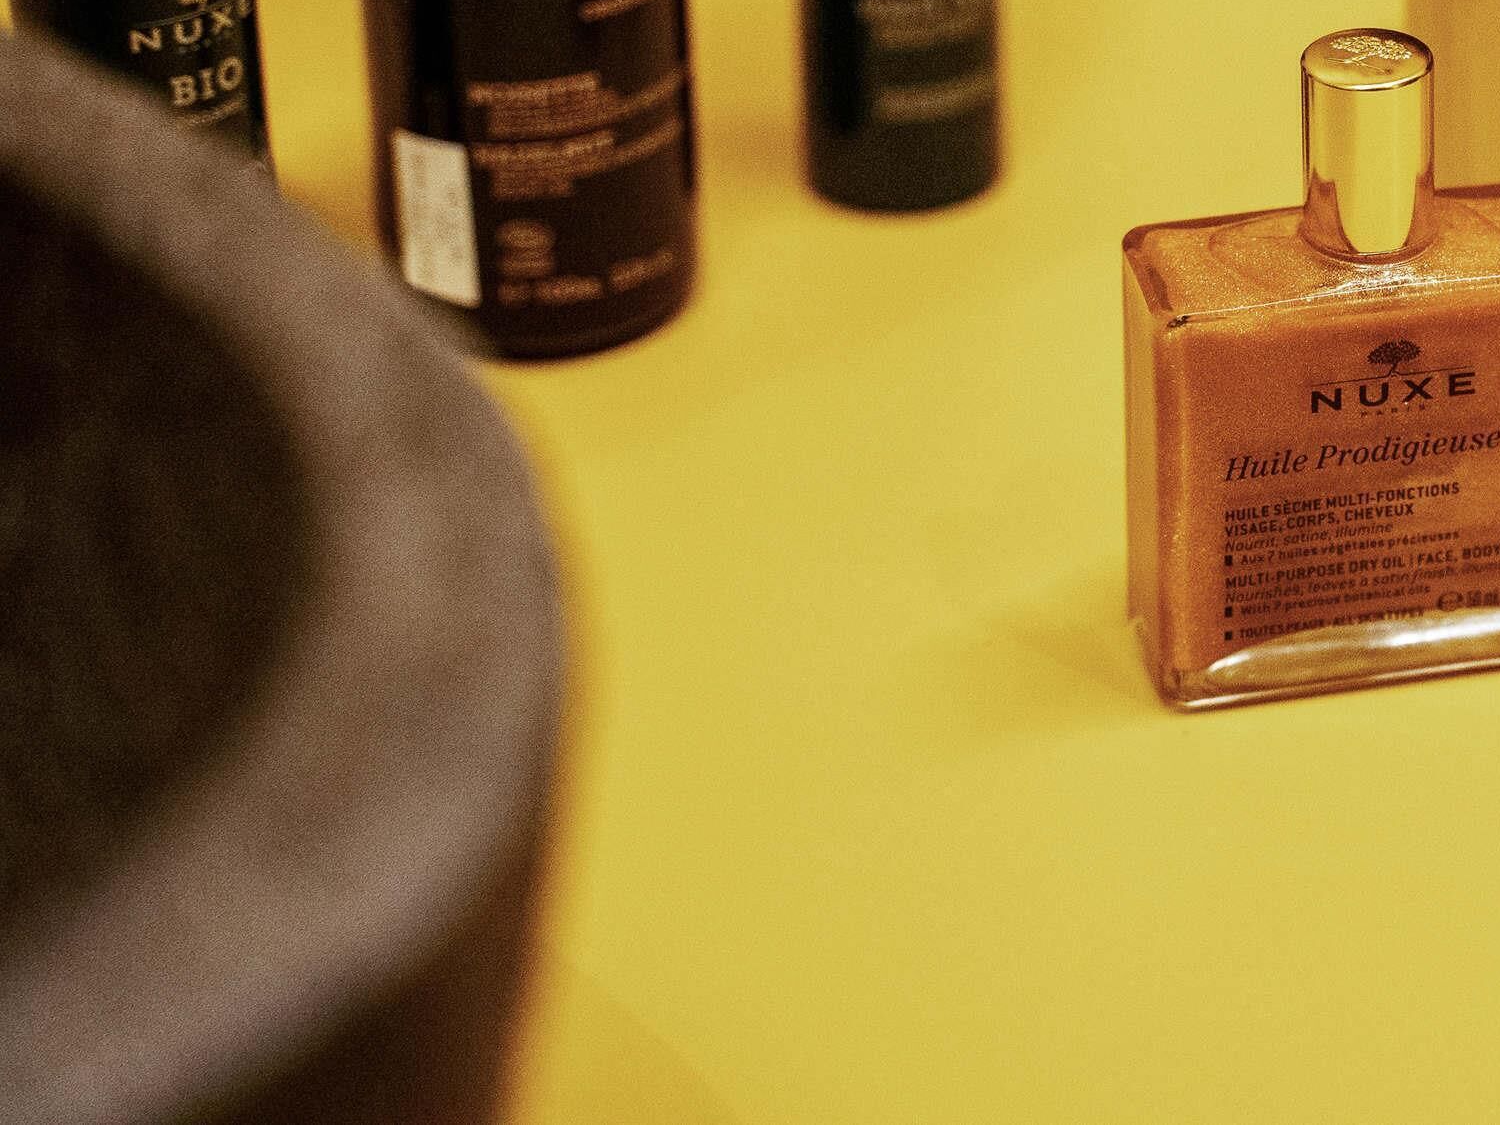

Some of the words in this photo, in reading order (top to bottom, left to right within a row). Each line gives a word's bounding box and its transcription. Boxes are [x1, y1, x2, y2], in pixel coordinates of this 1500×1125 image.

[170, 56, 245, 107] BIO
[1311, 371, 1477, 414] NUXE
[1224, 448, 1309, 482] Huile
[1225, 504, 1271, 523] HUILE
[1274, 499, 1321, 518] SÈCHE
[1326, 481, 1461, 508] MULTI-FONCTIONS
[1225, 519, 1283, 538] VISAGE,
[1287, 511, 1341, 530] CORPS,
[1344, 502, 1415, 523] CHEVEUX
[1335, 524, 1394, 540] illumine
[1225, 561, 1345, 589] MULTI-PURPOSE
[1348, 558, 1379, 574] DRY
[1382, 554, 1406, 570] OIL
[1417, 549, 1459, 566] FACE,
[1240, 554, 1265, 567] Aux
[1268, 549, 1276, 563] 7
[1279, 546, 1318, 561] huiles
